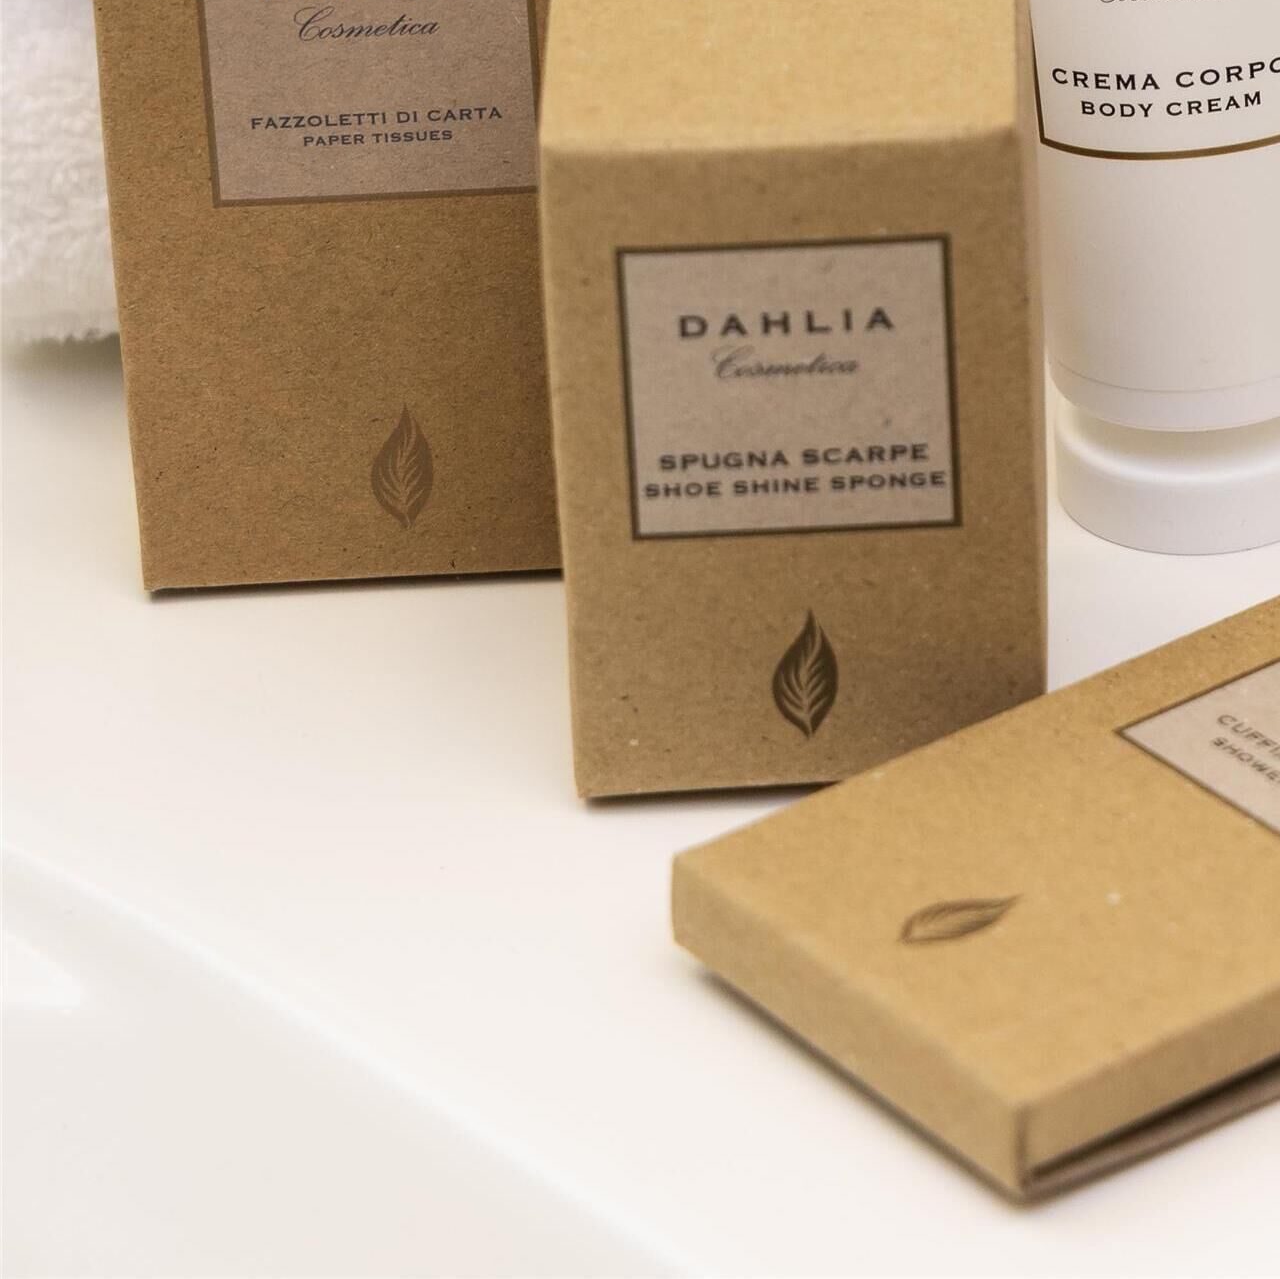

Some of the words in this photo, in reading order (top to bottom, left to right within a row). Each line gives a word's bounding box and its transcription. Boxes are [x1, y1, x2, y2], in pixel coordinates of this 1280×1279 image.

[293, 6, 440, 42] Cosmetica
[1052, 68, 1160, 90] CREMA
[1081, 101, 1153, 117] BODY
[1166, 92, 1261, 116] CREAM
[251, 112, 387, 130] FAZZOLETTI
[397, 111, 418, 124] DI
[428, 107, 502, 122] CARTA
[303, 133, 365, 147] PAPER
[372, 130, 453, 144] TISSUES
[678, 307, 895, 339] DAHLIA
[712, 344, 857, 379] Cosmetica
[659, 449, 789, 471] SPUGNA
[802, 443, 929, 464] SCARPE
[645, 481, 722, 498] SHOE
[733, 477, 820, 495] SHINE
[831, 471, 946, 490] SPONGE
